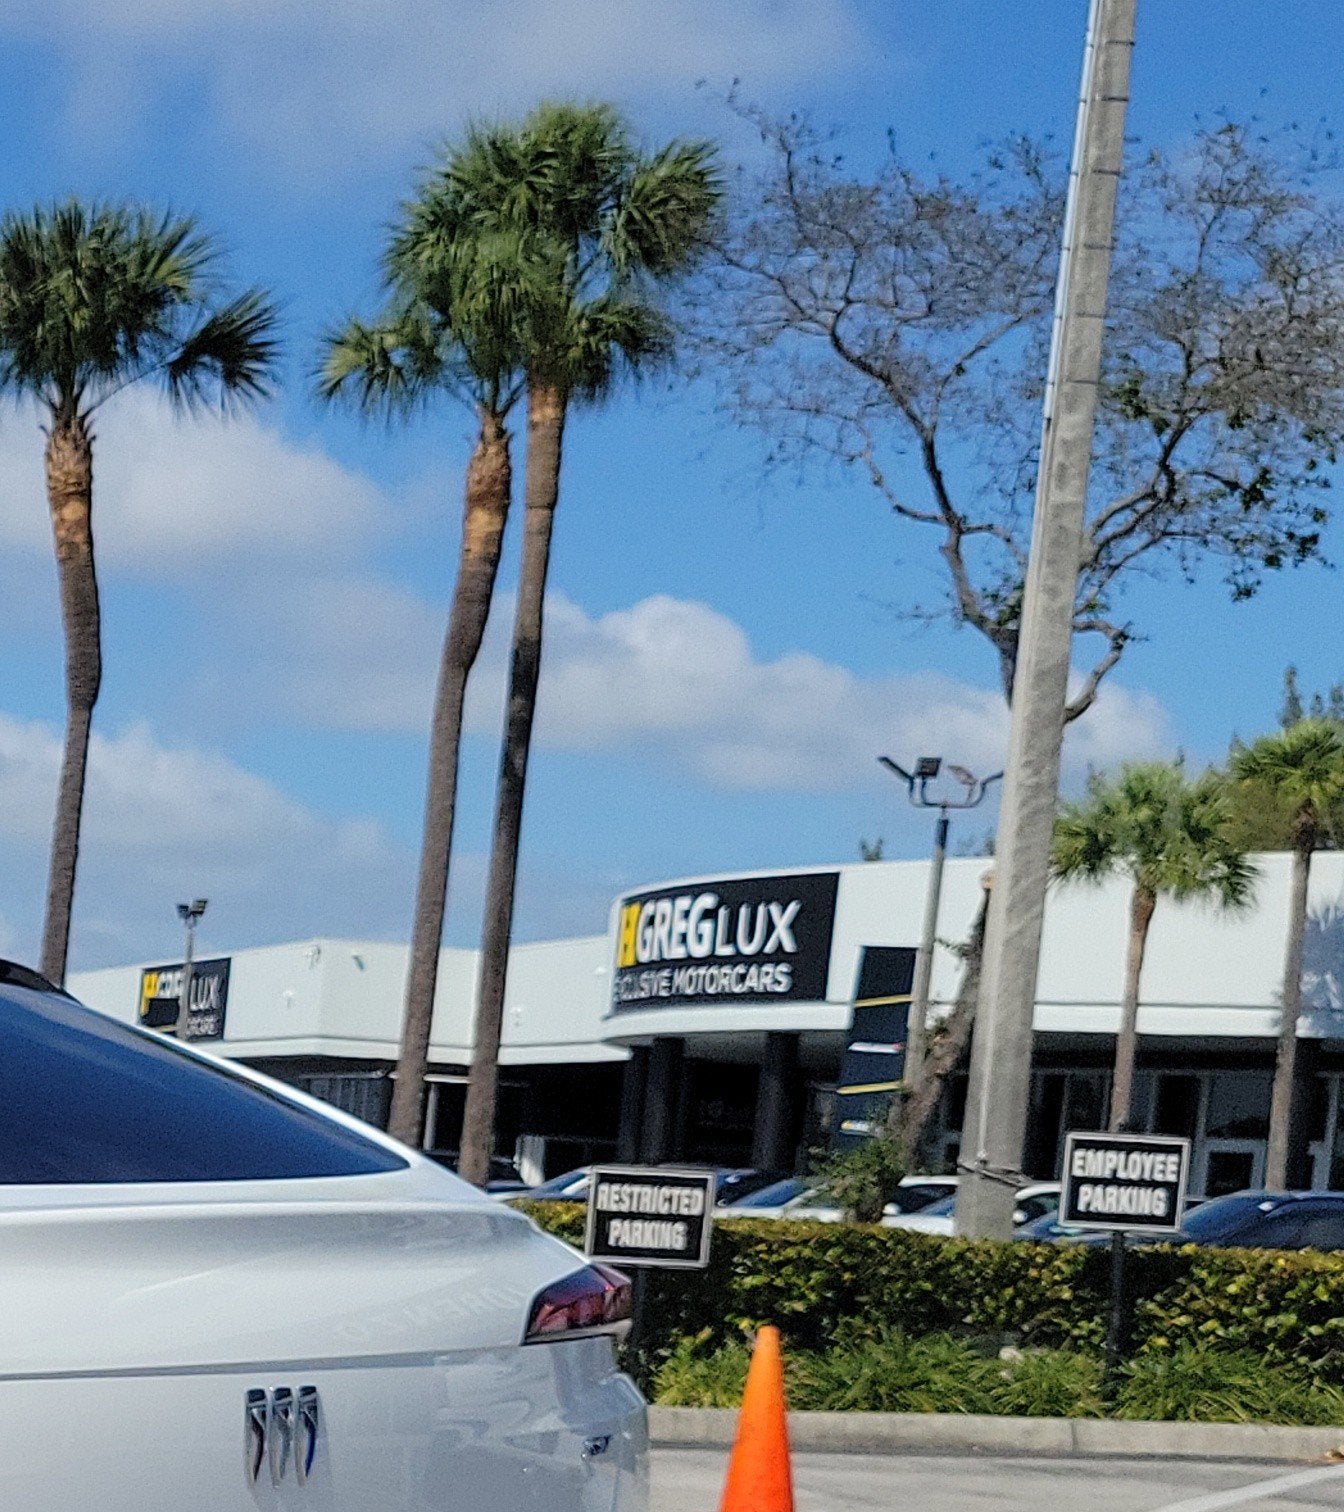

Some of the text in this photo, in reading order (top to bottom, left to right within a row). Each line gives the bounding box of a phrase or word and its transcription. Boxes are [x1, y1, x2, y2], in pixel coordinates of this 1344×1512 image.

[672, 962, 794, 997] MOTORCARS
[1072, 1148, 1180, 1183] EMPLOYEE
[595, 1182, 705, 1216] RESTRICTED
[1077, 1183, 1169, 1217] PARKING
[607, 1218, 688, 1250] PARKING
